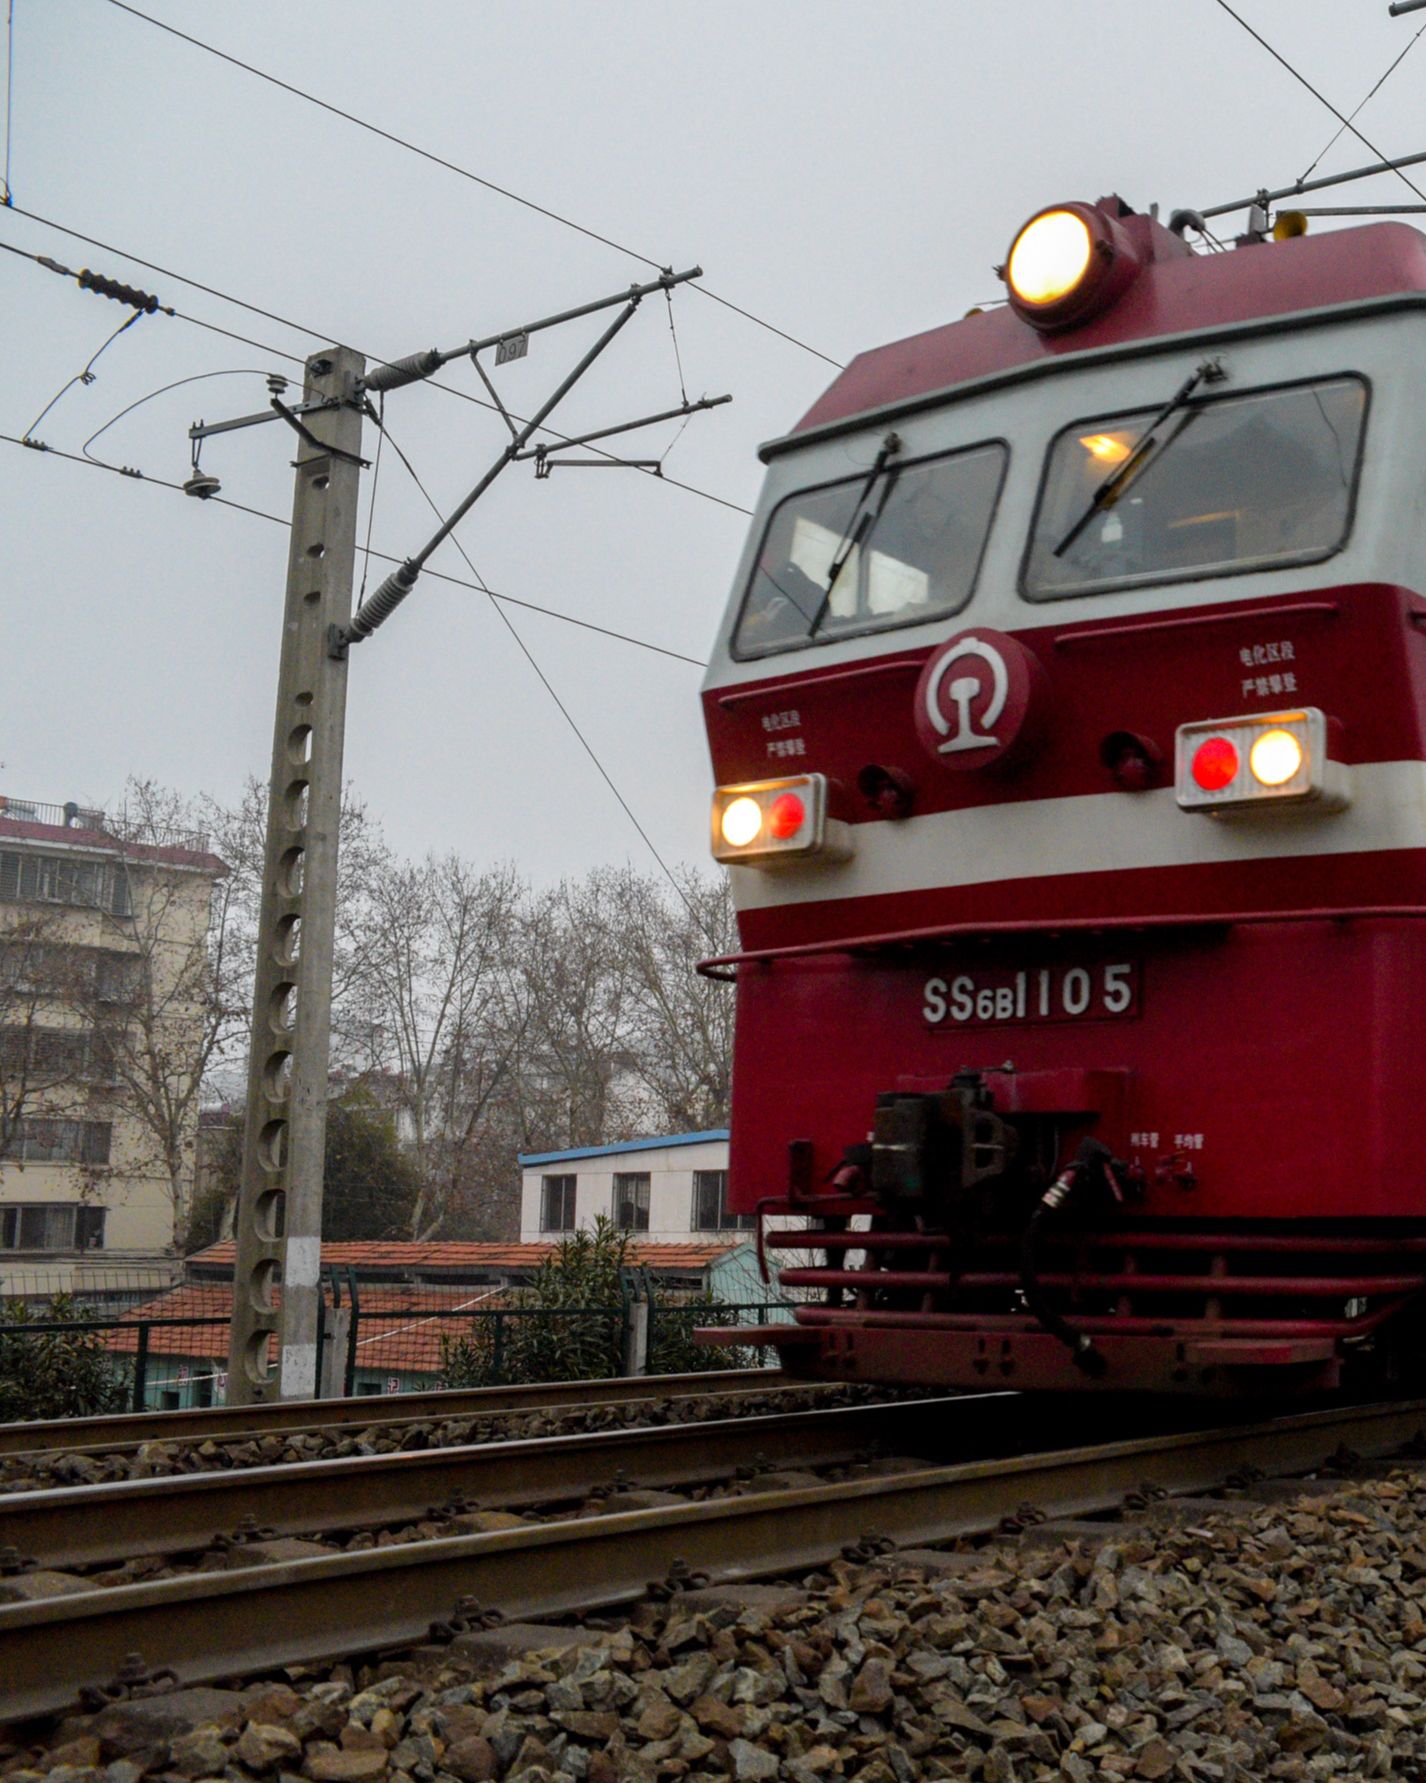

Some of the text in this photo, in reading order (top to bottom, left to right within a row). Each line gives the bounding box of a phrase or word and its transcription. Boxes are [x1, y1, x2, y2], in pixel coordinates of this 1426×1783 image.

[498, 340, 527, 364] 097
[1239, 640, 1296, 667] 电化区段
